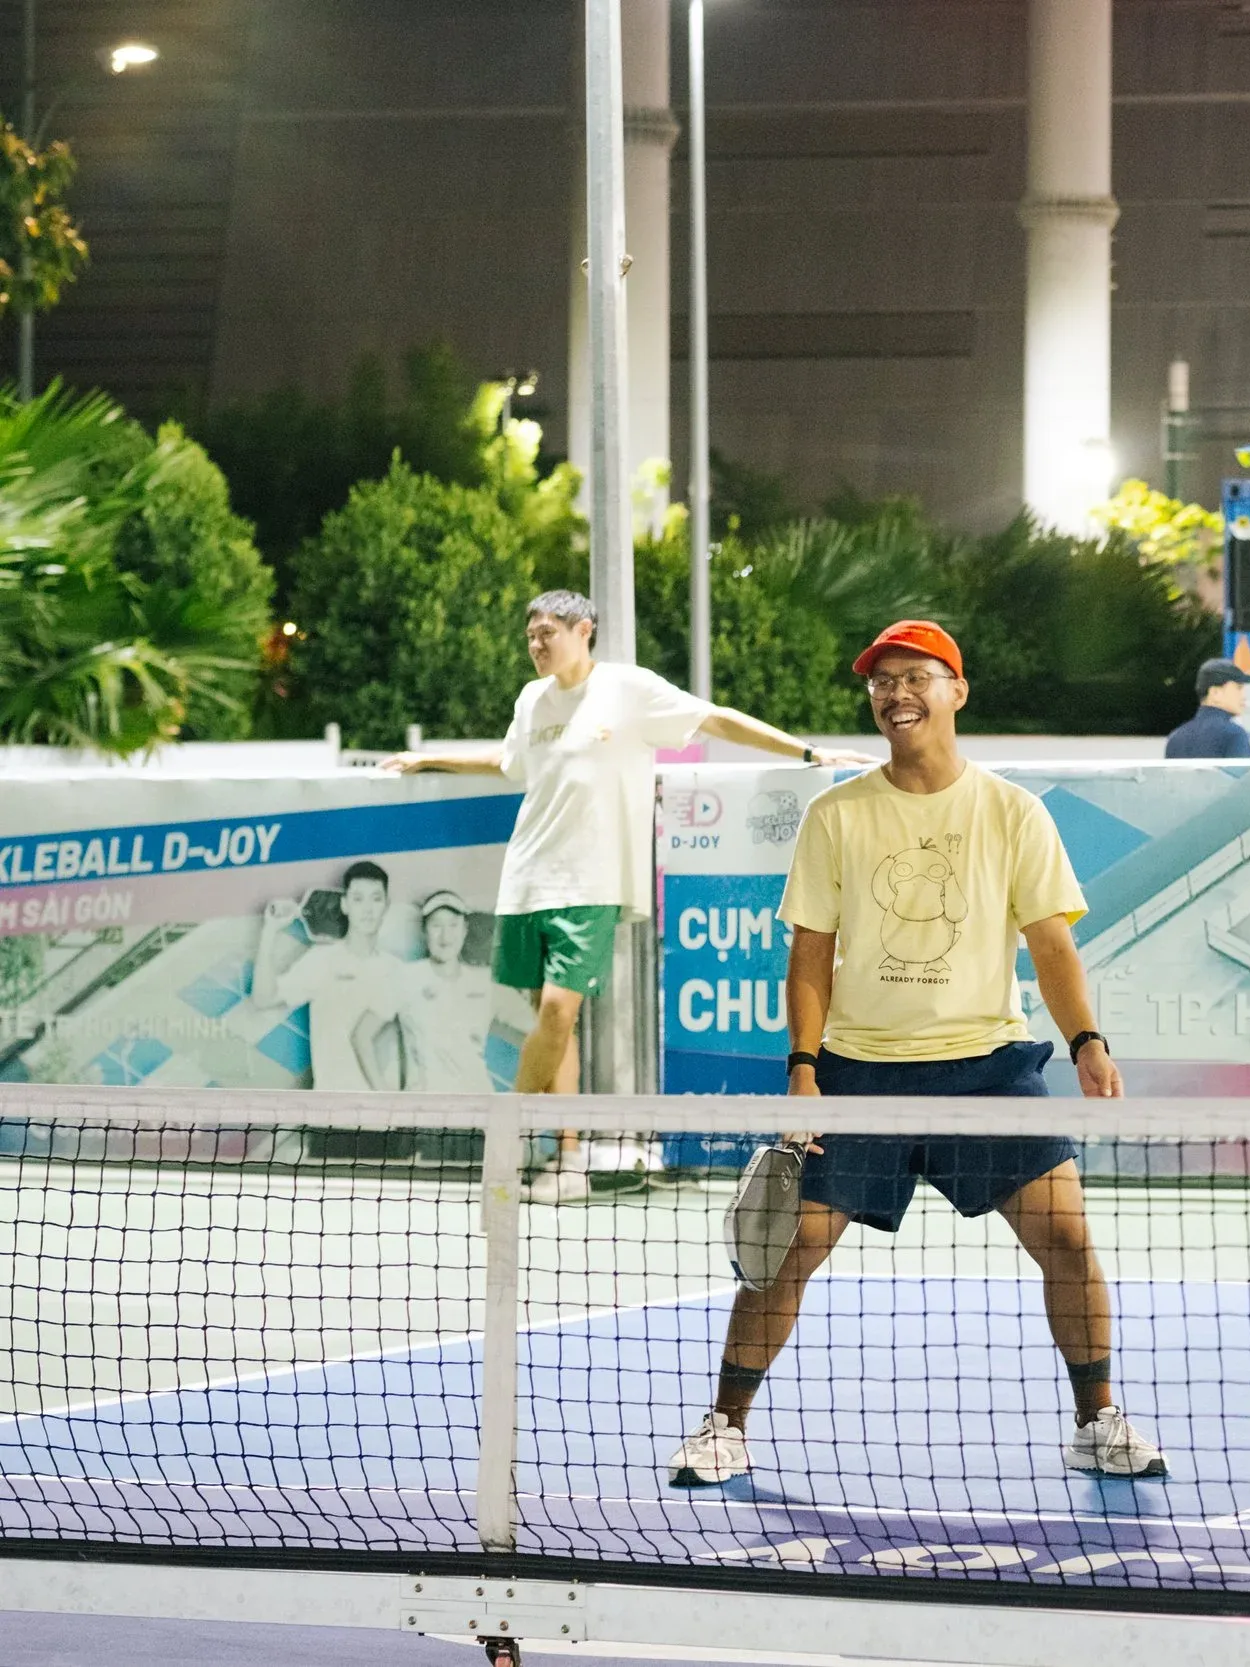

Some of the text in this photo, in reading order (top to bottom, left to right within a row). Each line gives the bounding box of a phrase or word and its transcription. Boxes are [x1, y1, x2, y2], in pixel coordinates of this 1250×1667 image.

[162, 823, 281, 870] D-JOY
[671, 836, 721, 849] D-JOY
[678, 907, 772, 963] CỤM
[879, 975, 950, 985] ALREADY FORGOT
